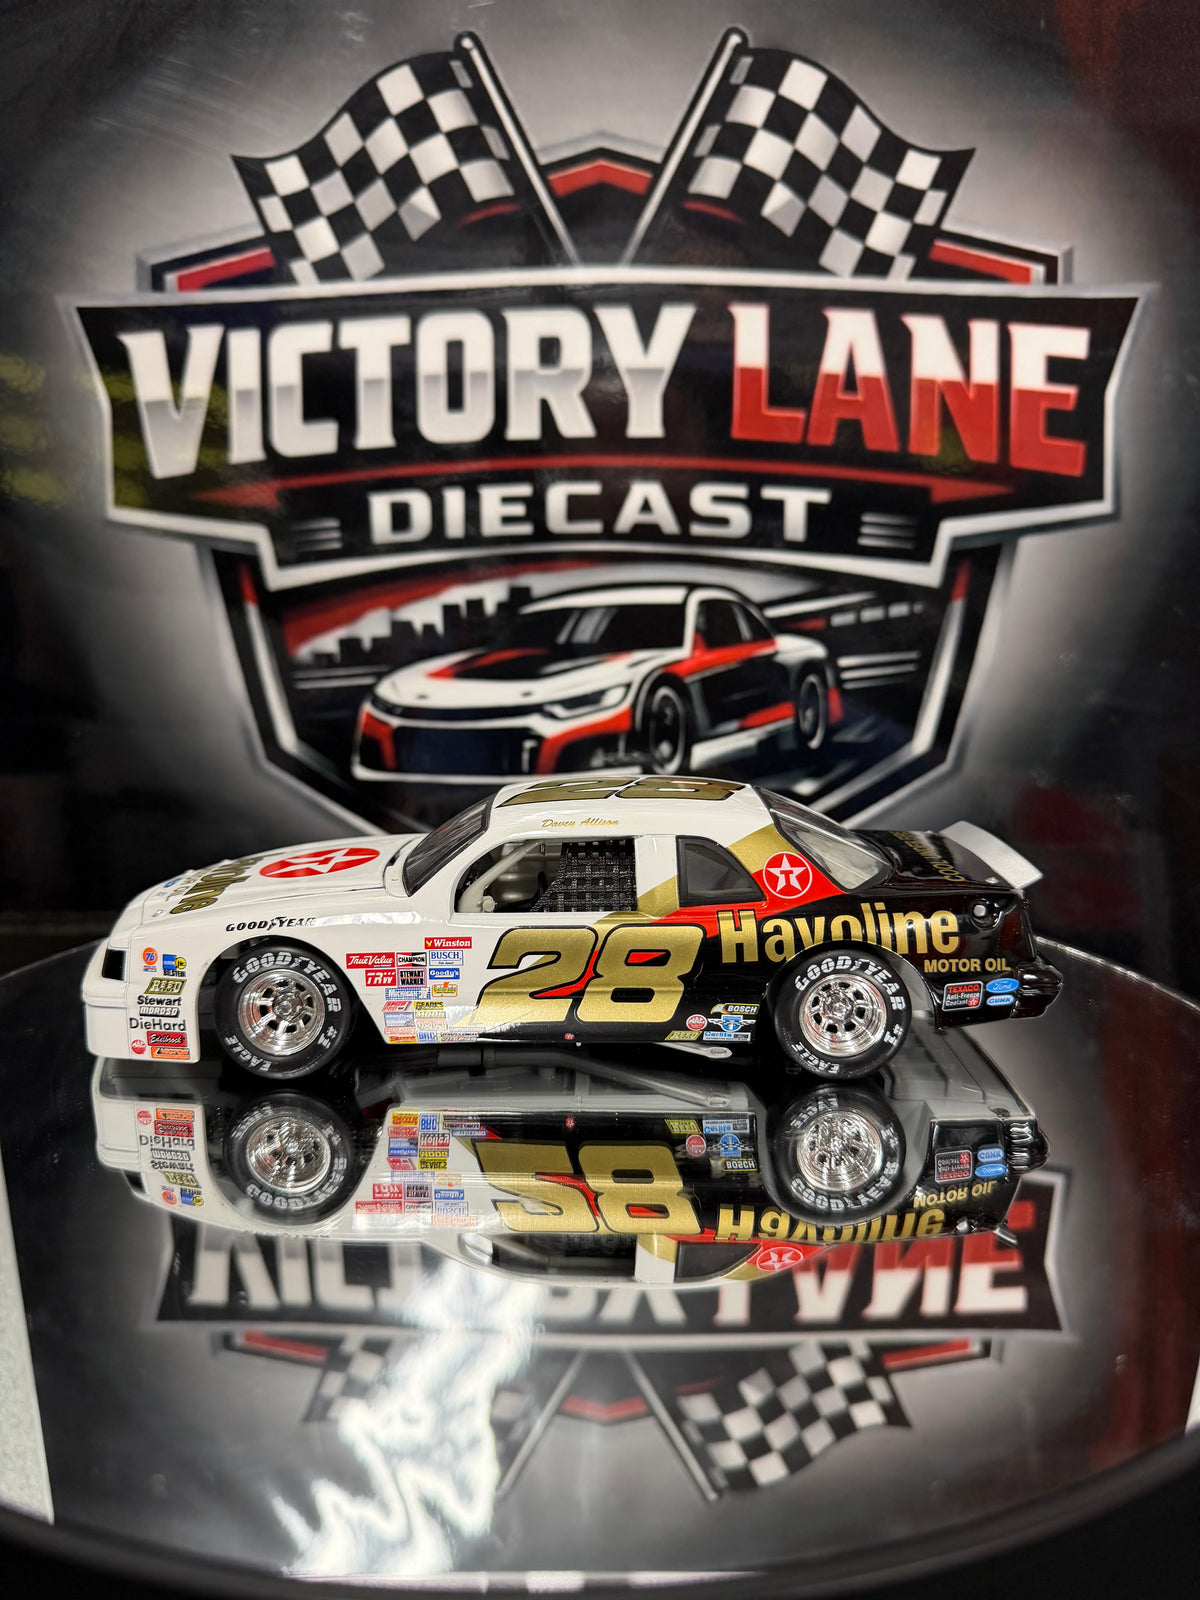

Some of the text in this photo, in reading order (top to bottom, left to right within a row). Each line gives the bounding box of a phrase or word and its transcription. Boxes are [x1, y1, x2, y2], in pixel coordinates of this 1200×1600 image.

[117, 302, 1092, 480] VICTORY LANE
[368, 482, 833, 546] DIECAST
[541, 817, 620, 830] Davey Allison
[225, 916, 316, 932] GOODYEAR
[717, 901, 960, 964] Havoline
[434, 939, 471, 947] Winston
[145, 952, 155, 961] 76
[924, 957, 1012, 973] MOTOR OIL
[366, 972, 396, 985] TRW
[470, 923, 707, 1023] 28
[232, 951, 342, 1013] GOODYEAR
[794, 955, 907, 1011] GOODYEAR
[948, 984, 980, 993] TEXACO
[137, 996, 182, 1006] Stewart
[946, 992, 980, 1000] Anti-Freeze
[727, 1005, 758, 1013] BOSCH
[129, 1017, 187, 1032] DieHard
[224, 1035, 272, 1072] EAGLE
